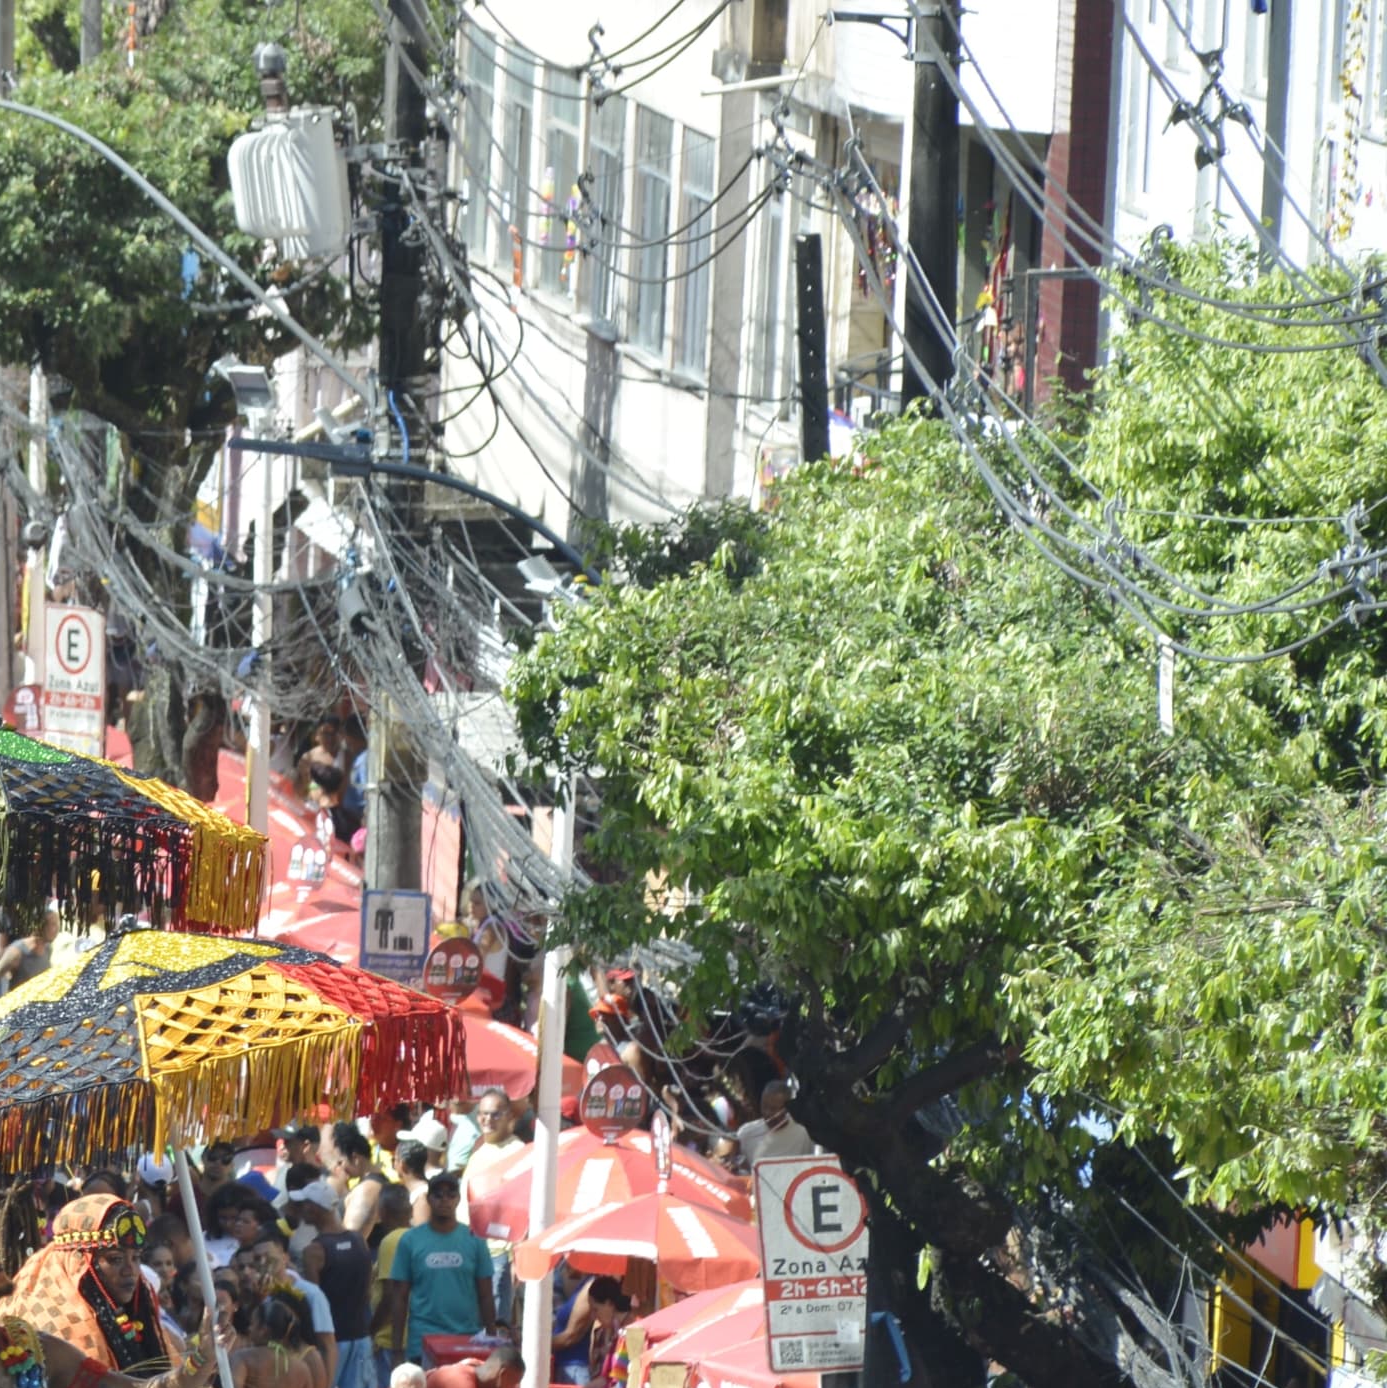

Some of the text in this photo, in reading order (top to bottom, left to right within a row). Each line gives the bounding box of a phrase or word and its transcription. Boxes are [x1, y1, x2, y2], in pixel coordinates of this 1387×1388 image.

[66, 628, 80, 662] E
[811, 1184, 843, 1234] E
[773, 1254, 868, 1276] Zona Az
[780, 1278, 868, 1299] 2h-6h-12
